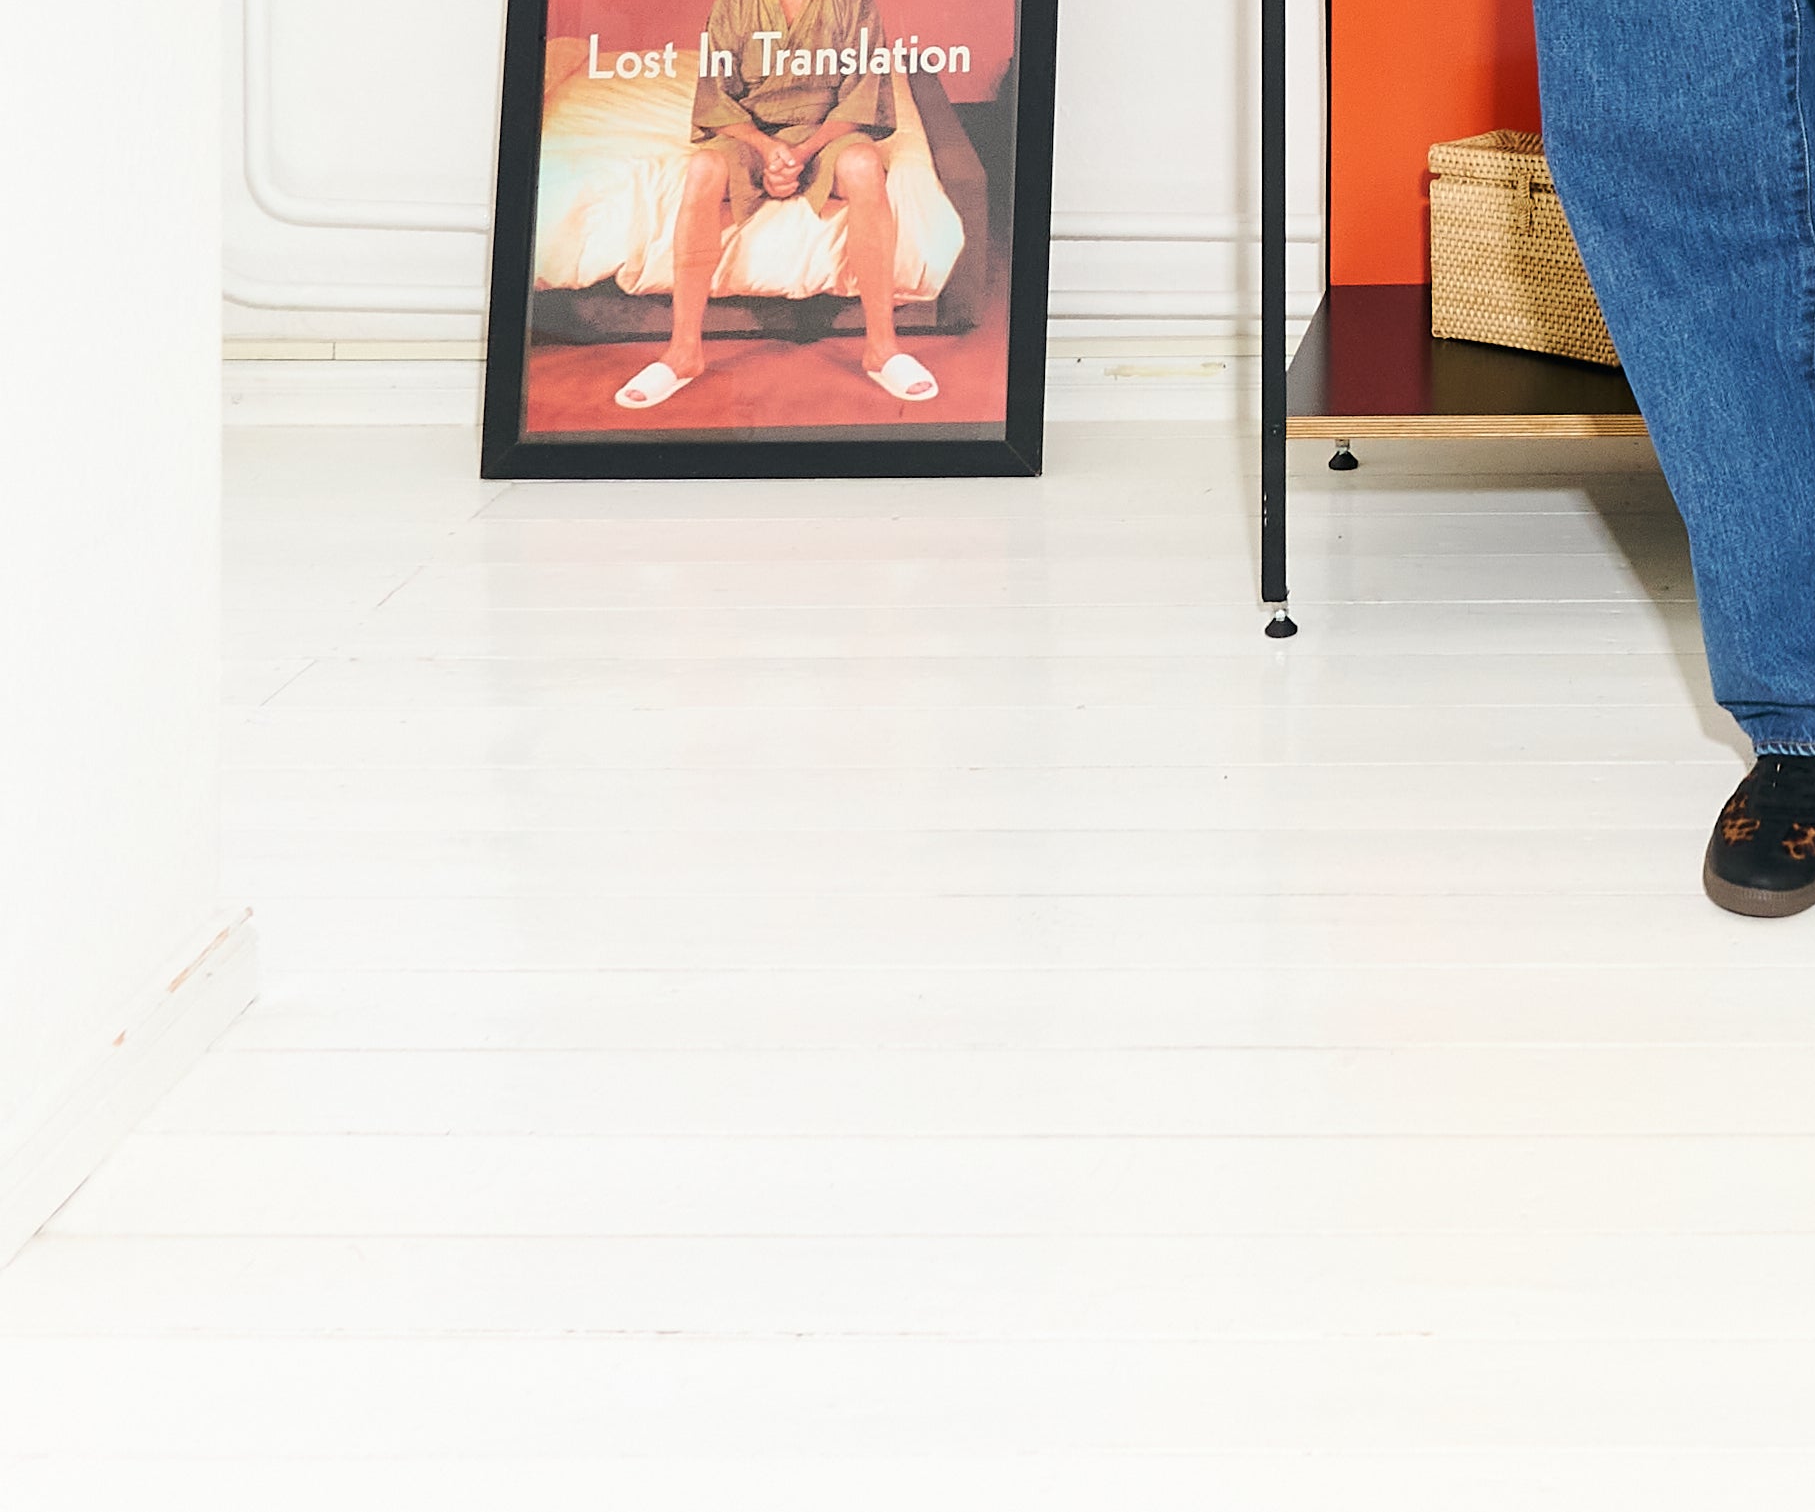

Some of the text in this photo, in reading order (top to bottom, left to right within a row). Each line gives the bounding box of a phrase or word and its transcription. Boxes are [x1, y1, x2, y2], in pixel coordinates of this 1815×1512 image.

[588, 27, 971, 80] Lost In Translation
